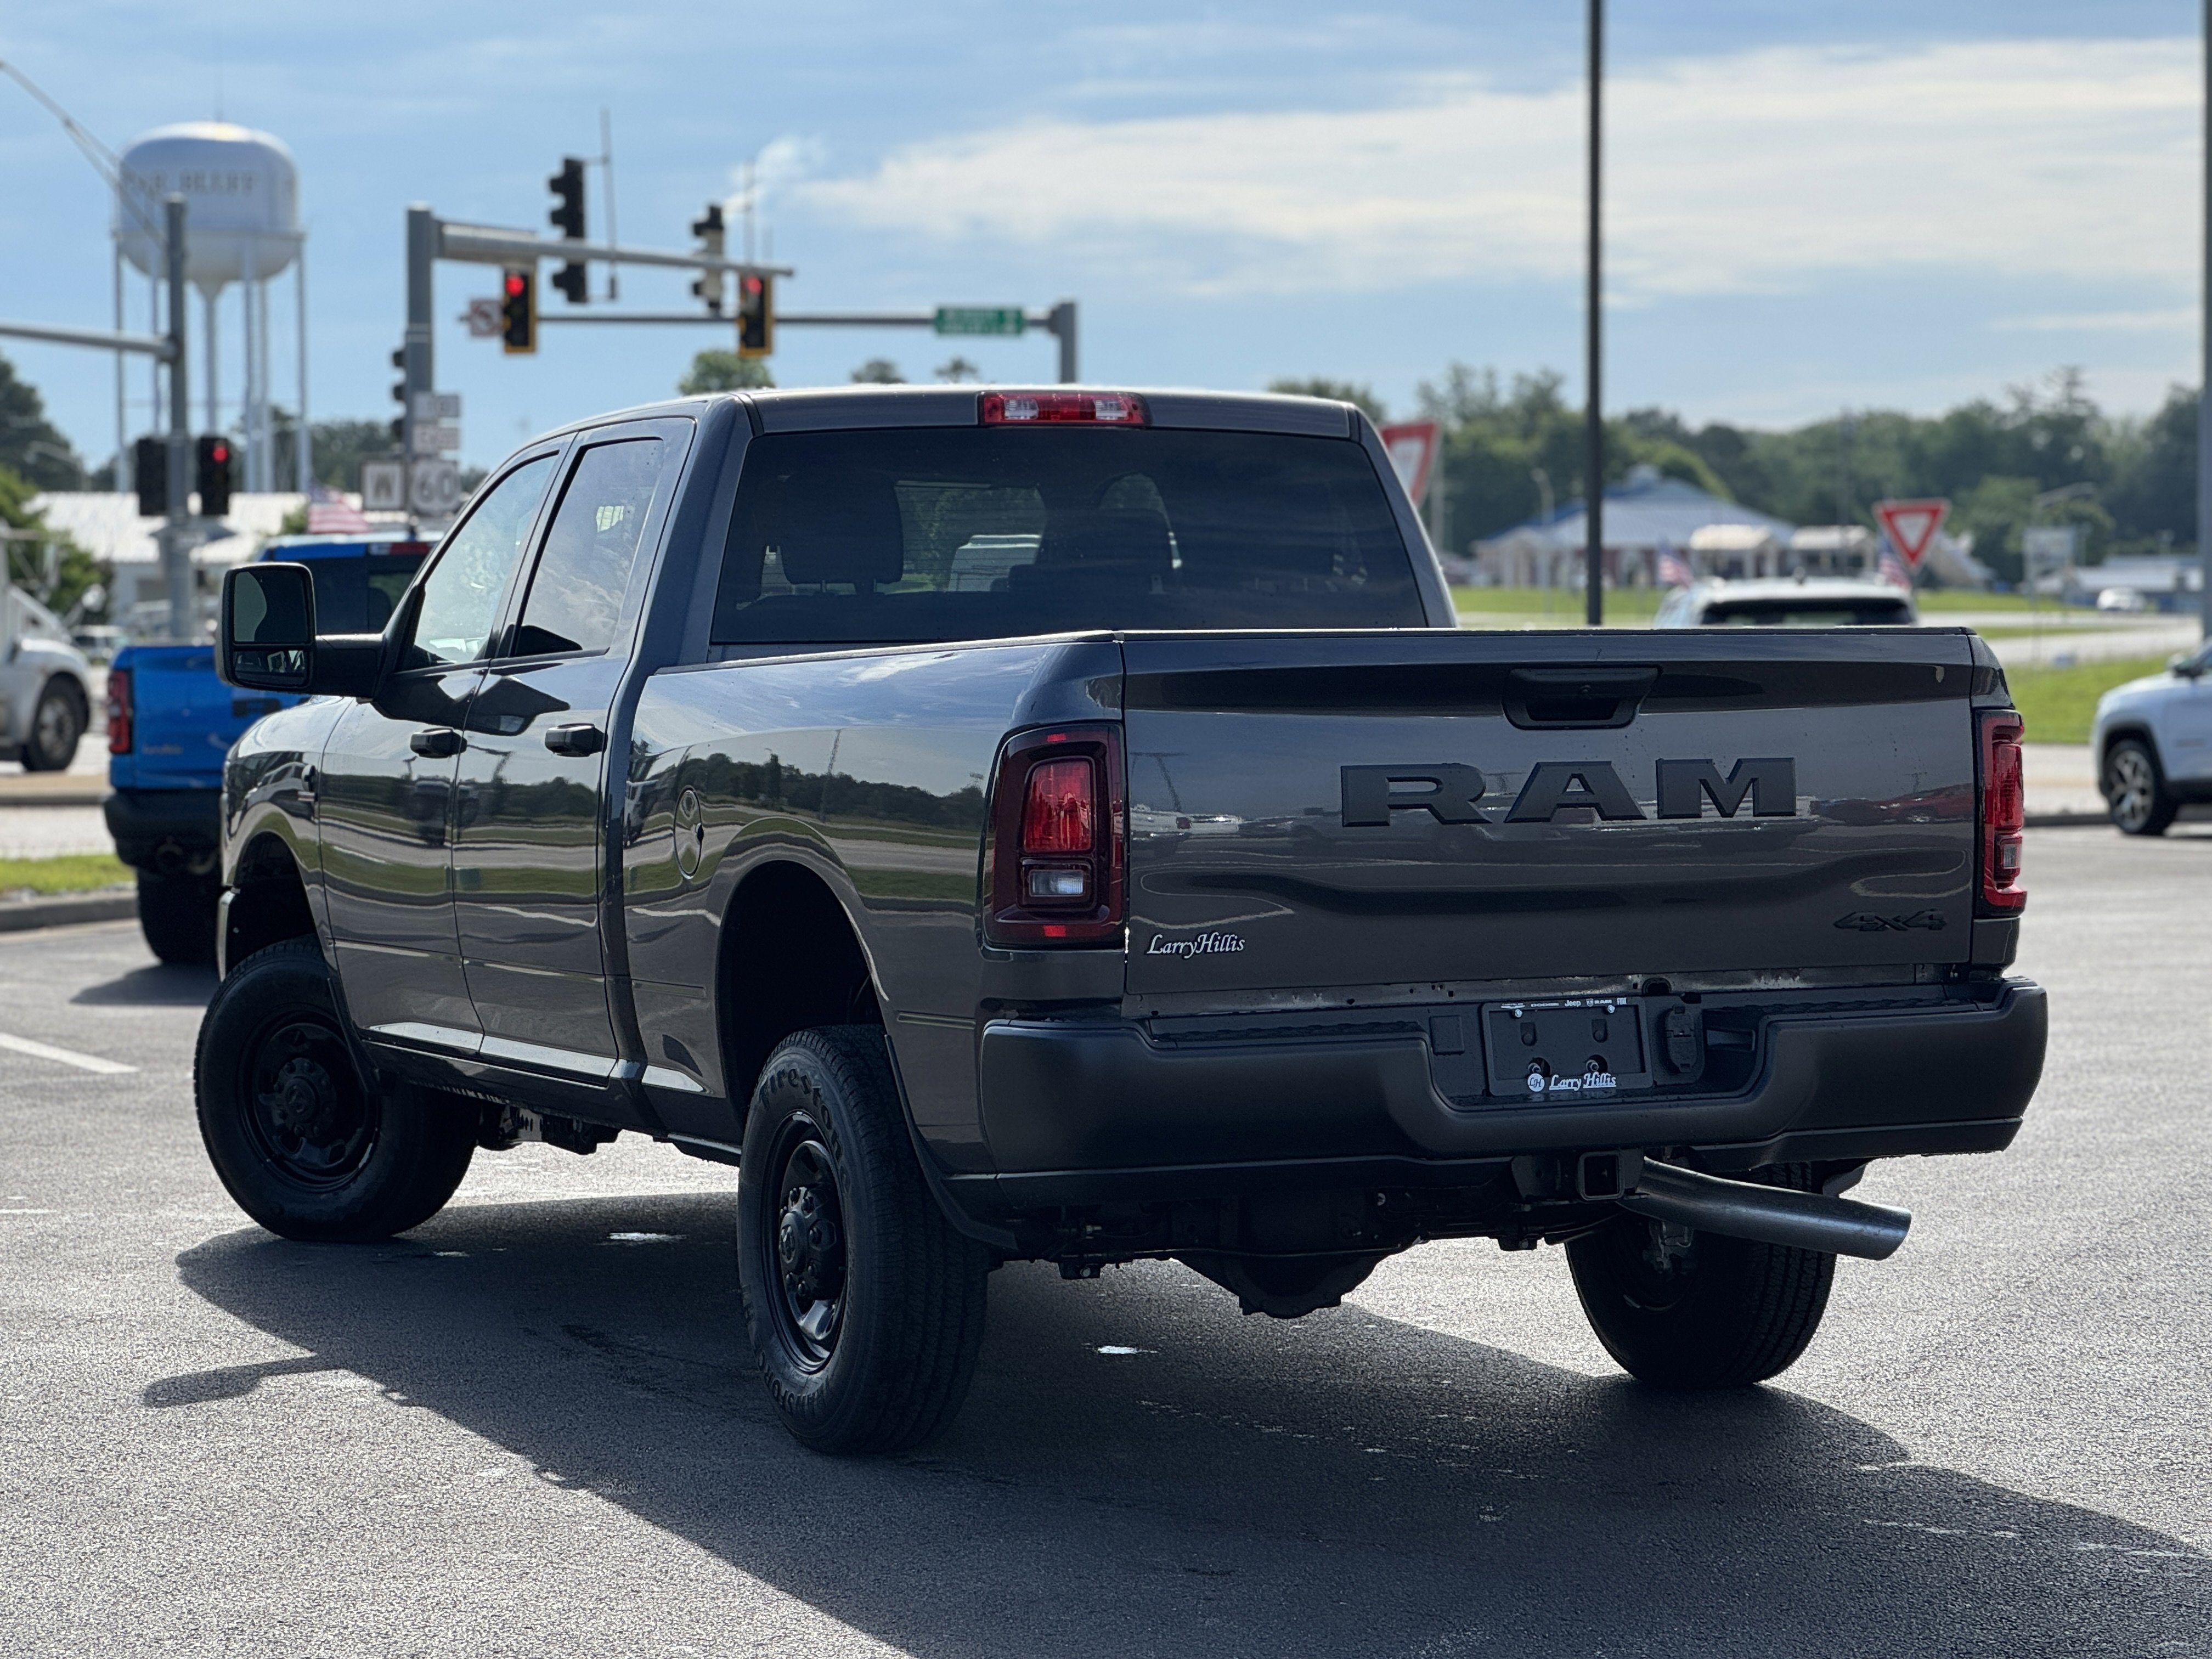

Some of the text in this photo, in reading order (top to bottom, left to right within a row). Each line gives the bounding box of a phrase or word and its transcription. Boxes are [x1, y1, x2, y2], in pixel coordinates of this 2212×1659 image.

[1340, 757, 1797, 827] RAM
[1549, 1074, 1582, 1091] Larry
[1583, 1071, 1617, 1089] Hillis
[758, 1068, 851, 1197] Firestone
